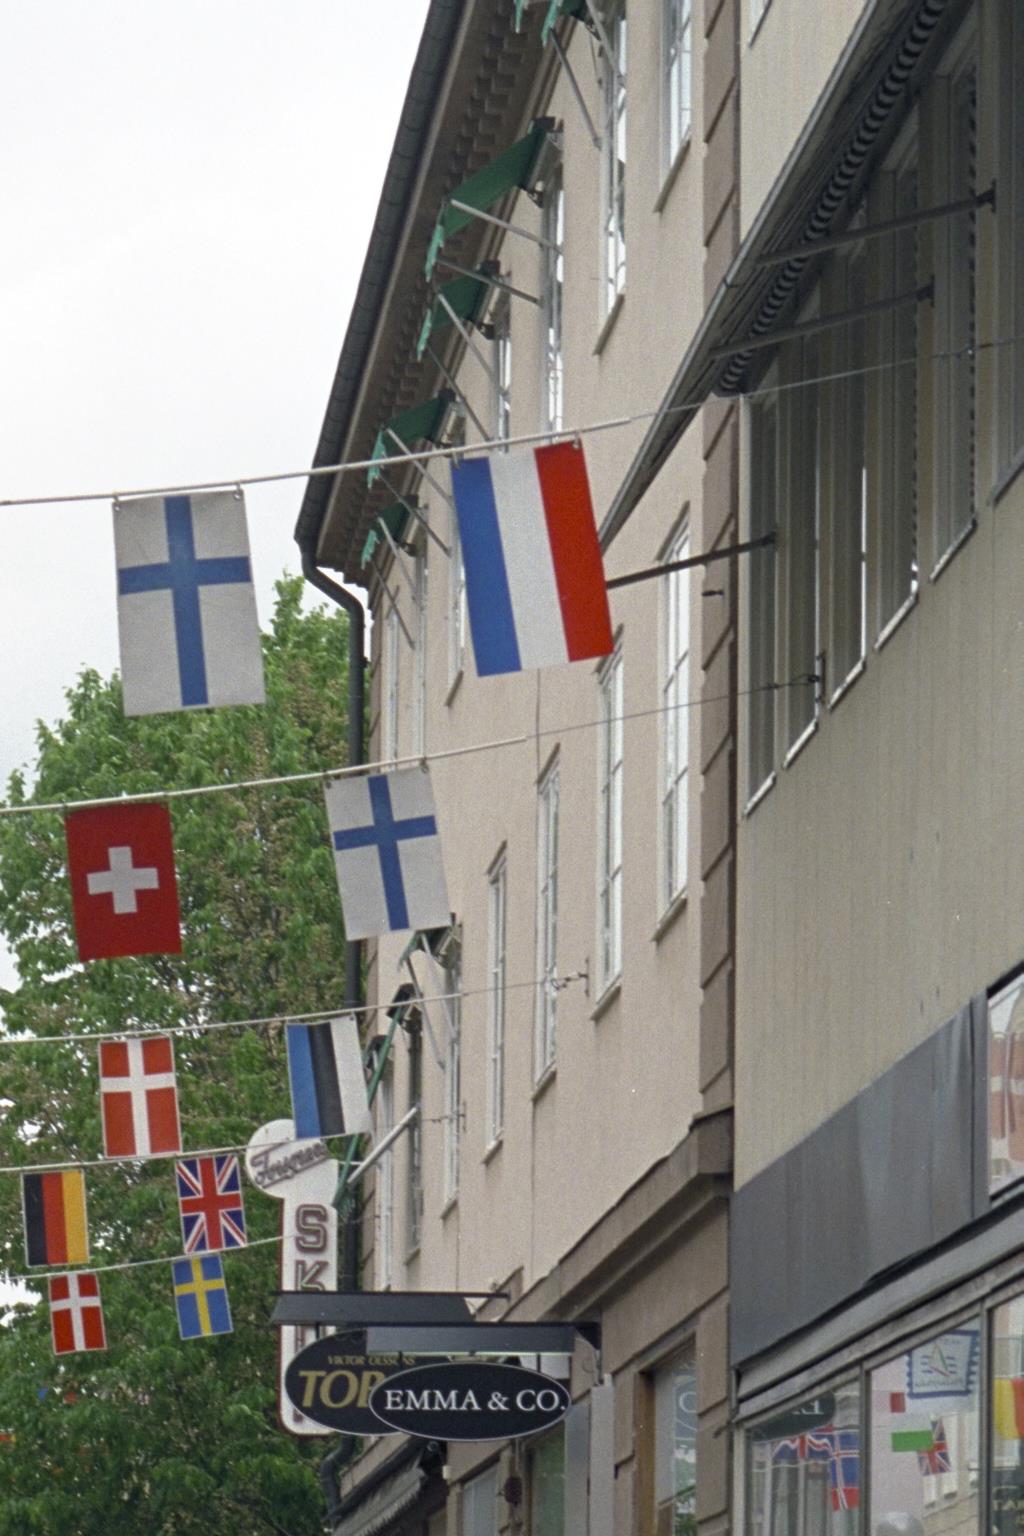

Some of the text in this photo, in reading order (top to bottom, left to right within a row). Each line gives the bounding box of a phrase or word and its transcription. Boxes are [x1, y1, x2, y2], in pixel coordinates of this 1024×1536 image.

[384, 1389, 566, 1411] EMMA & CO.
